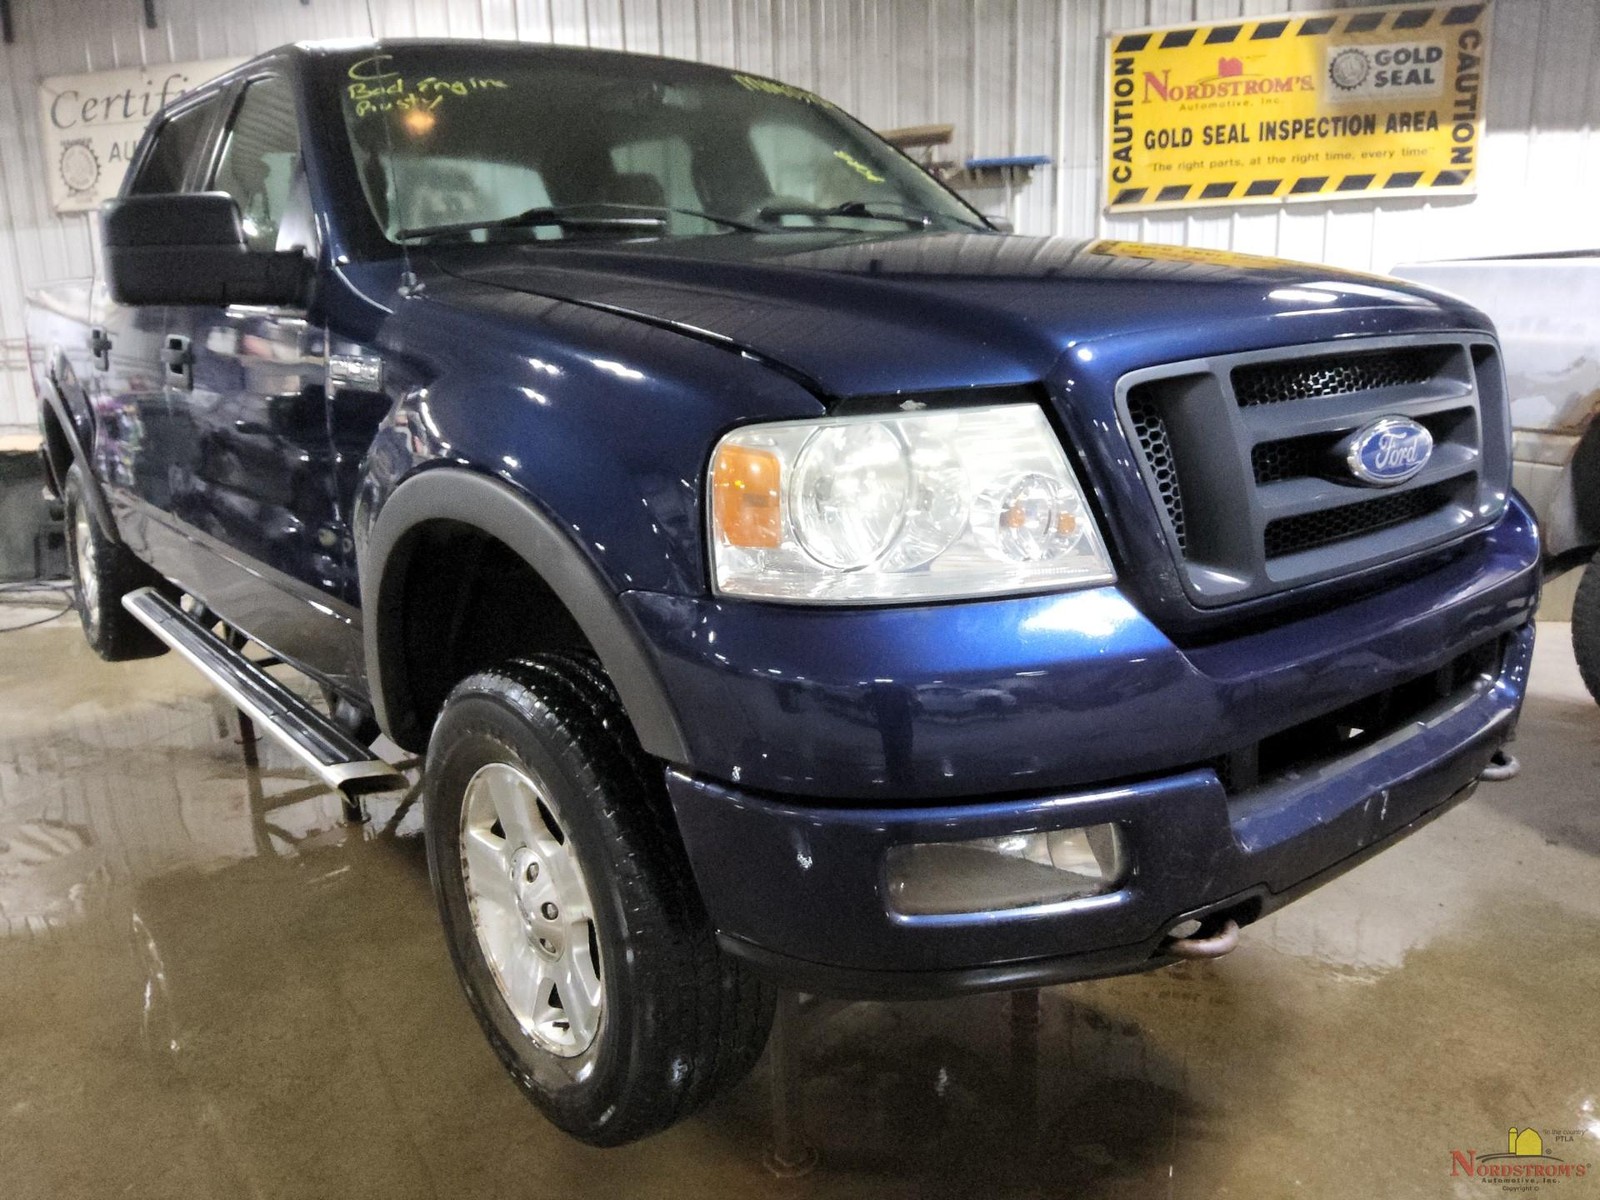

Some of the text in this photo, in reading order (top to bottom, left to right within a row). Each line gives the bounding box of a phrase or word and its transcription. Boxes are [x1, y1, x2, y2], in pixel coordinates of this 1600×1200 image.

[1374, 46, 1443, 66] GOLD
[1374, 68, 1436, 88] SEAL
[1450, 29, 1482, 165] CAUTION
[1112, 57, 1135, 184] CAUTION
[1144, 111, 1439, 150] GOLD SEAL INSPECTION AREA
[1178, 160, 1204, 171] right
[1209, 158, 1244, 169] parts,
[1249, 156, 1261, 165] at
[1267, 155, 1287, 165] the
[1291, 153, 1319, 164] right
[1361, 149, 1396, 160] every
[1375, 432, 1418, 469] Ford
